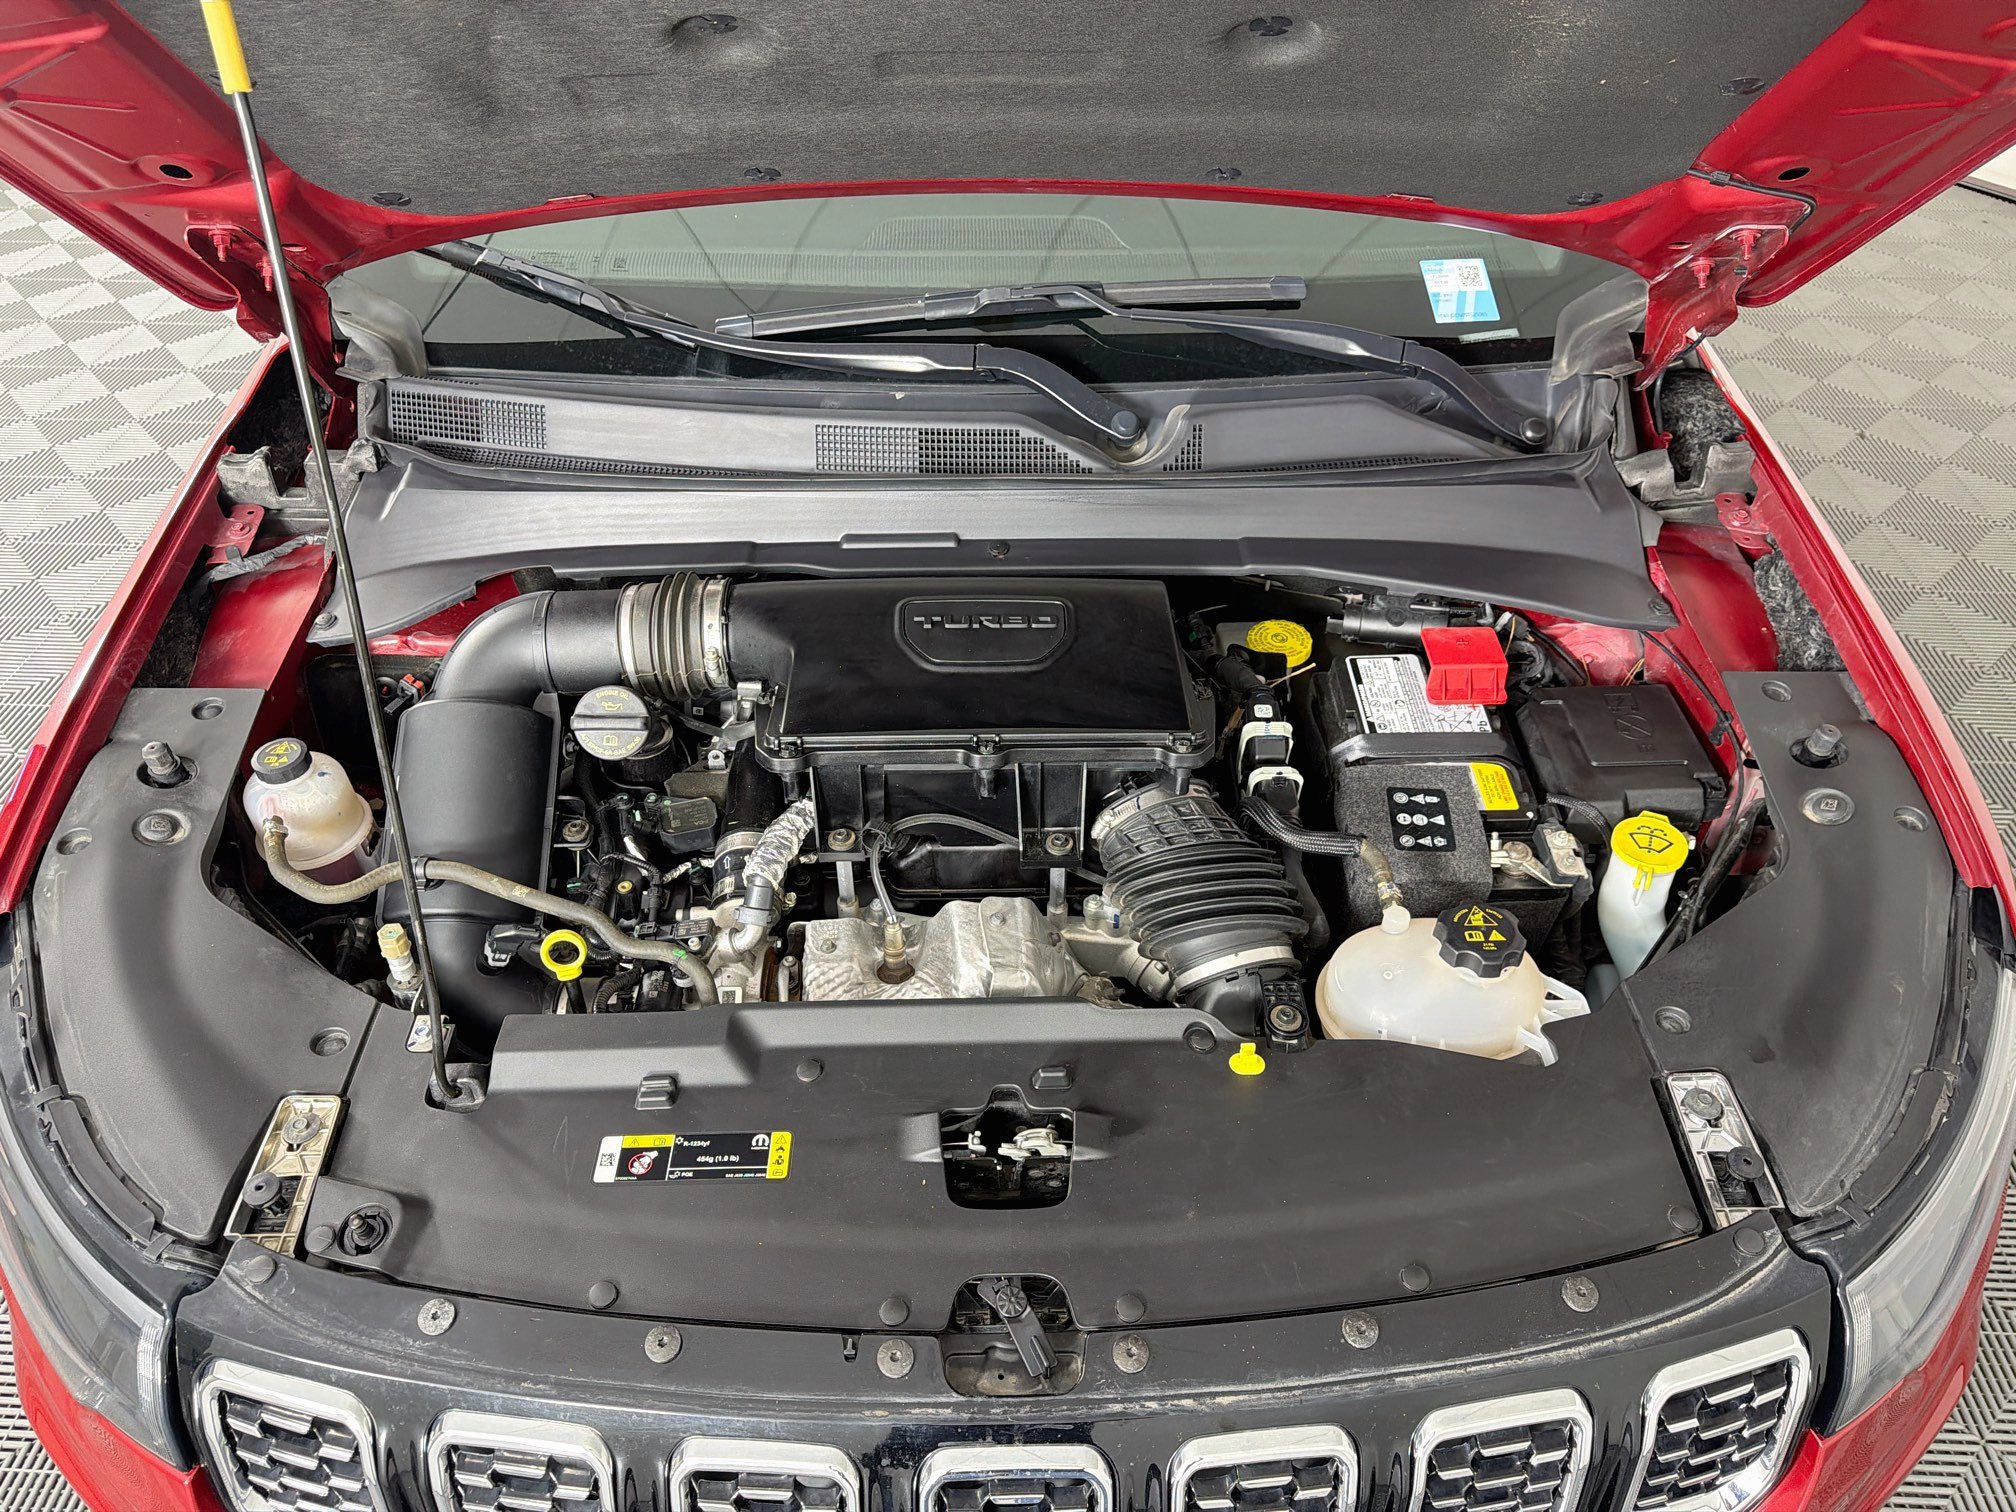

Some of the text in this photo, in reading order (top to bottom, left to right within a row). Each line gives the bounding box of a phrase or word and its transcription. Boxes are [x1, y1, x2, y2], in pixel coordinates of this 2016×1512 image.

[913, 615, 1058, 629] TURBO
[596, 690, 629, 700] ENGINE OIL
[696, 1155, 714, 1163] 454g
[729, 1154, 740, 1163] lb)
